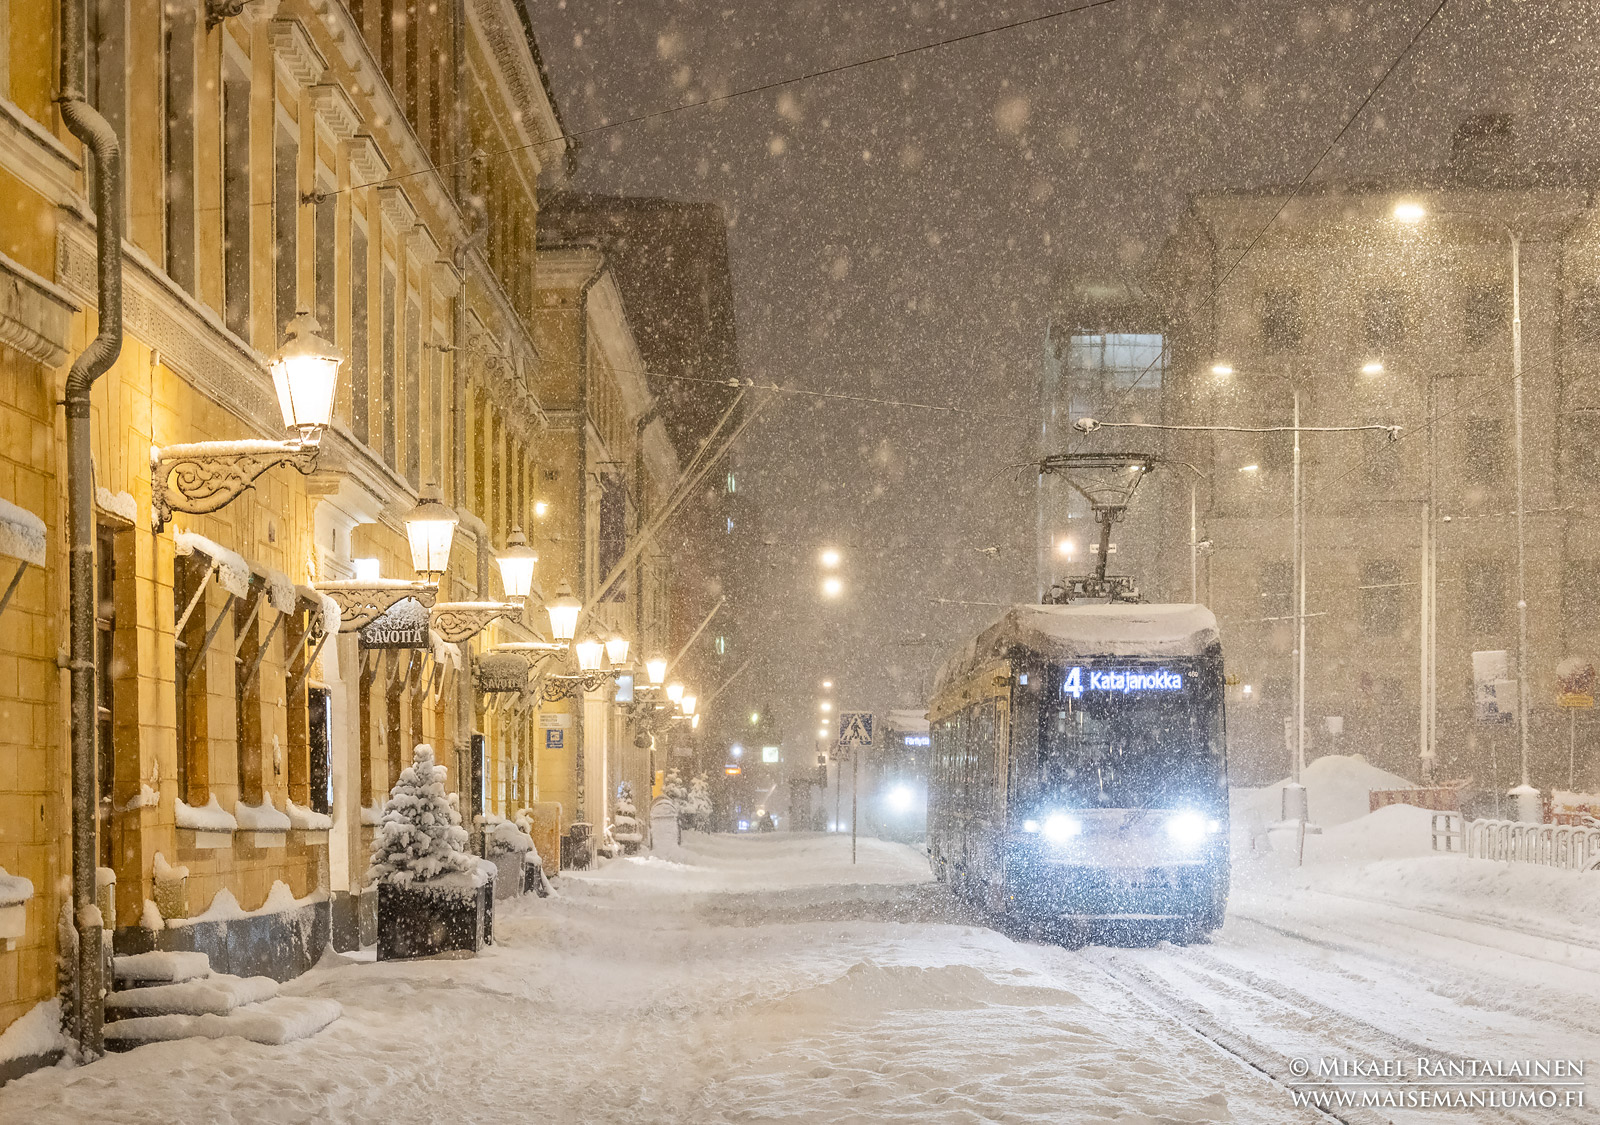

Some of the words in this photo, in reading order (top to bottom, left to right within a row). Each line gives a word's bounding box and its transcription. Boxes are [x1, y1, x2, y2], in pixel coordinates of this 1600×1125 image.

[366, 629, 423, 644] SAVOTTA
[1063, 667, 1084, 698] 4
[1090, 671, 1182, 694] Katajanokka
